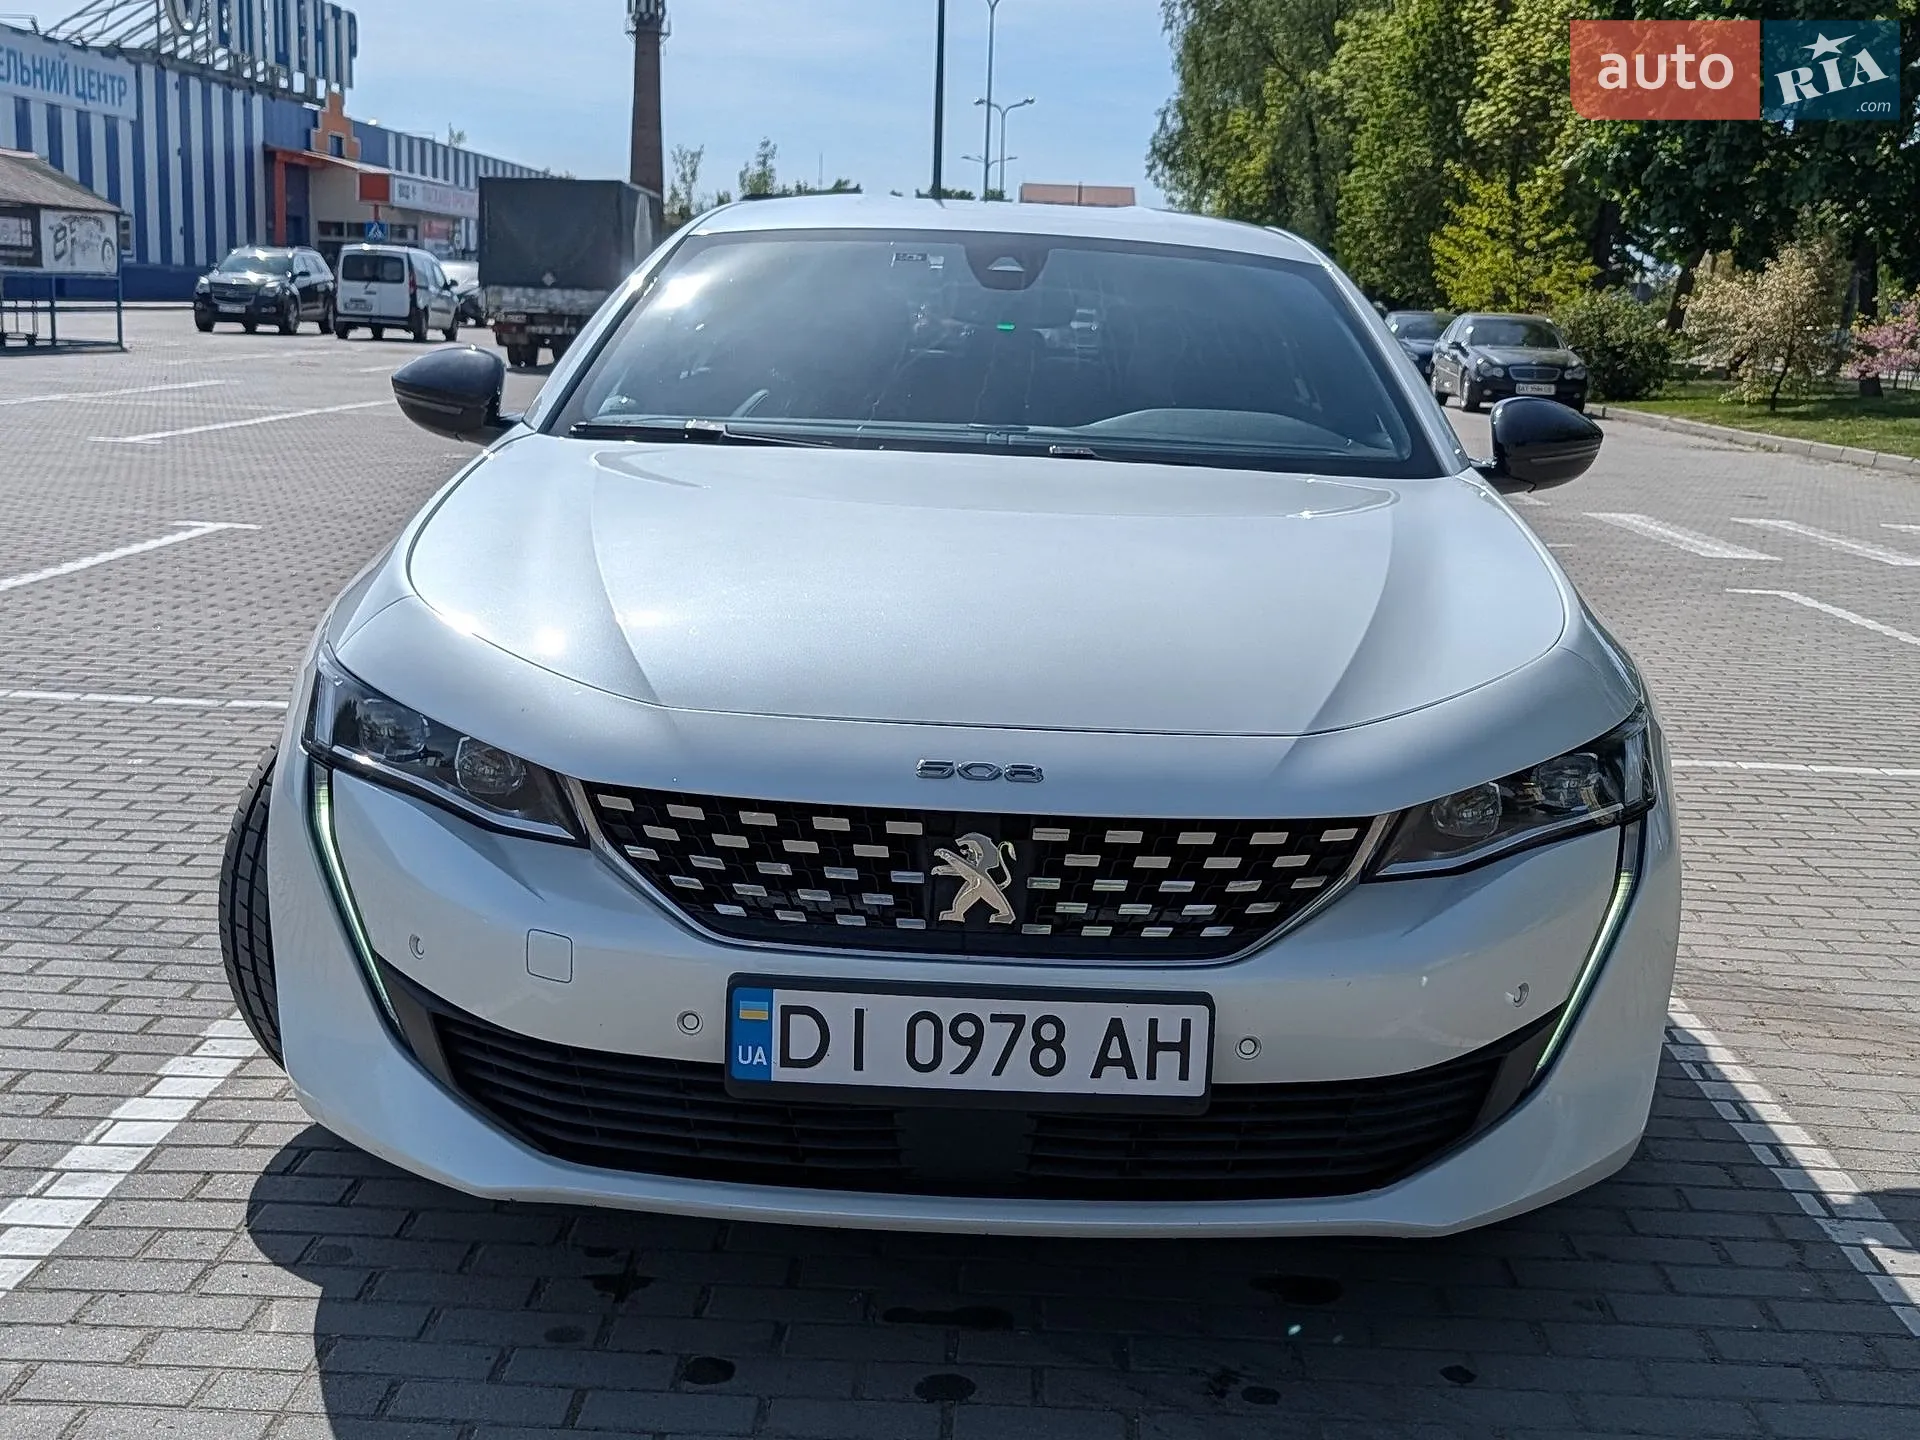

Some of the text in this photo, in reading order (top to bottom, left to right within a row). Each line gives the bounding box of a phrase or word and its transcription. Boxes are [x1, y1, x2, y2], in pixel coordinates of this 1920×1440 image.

[74, 63, 127, 107] ЦЕНТР
[916, 758, 1044, 783] 508
[738, 1045, 768, 1066] UA
[779, 1004, 1192, 1081] DI 0978 AH
